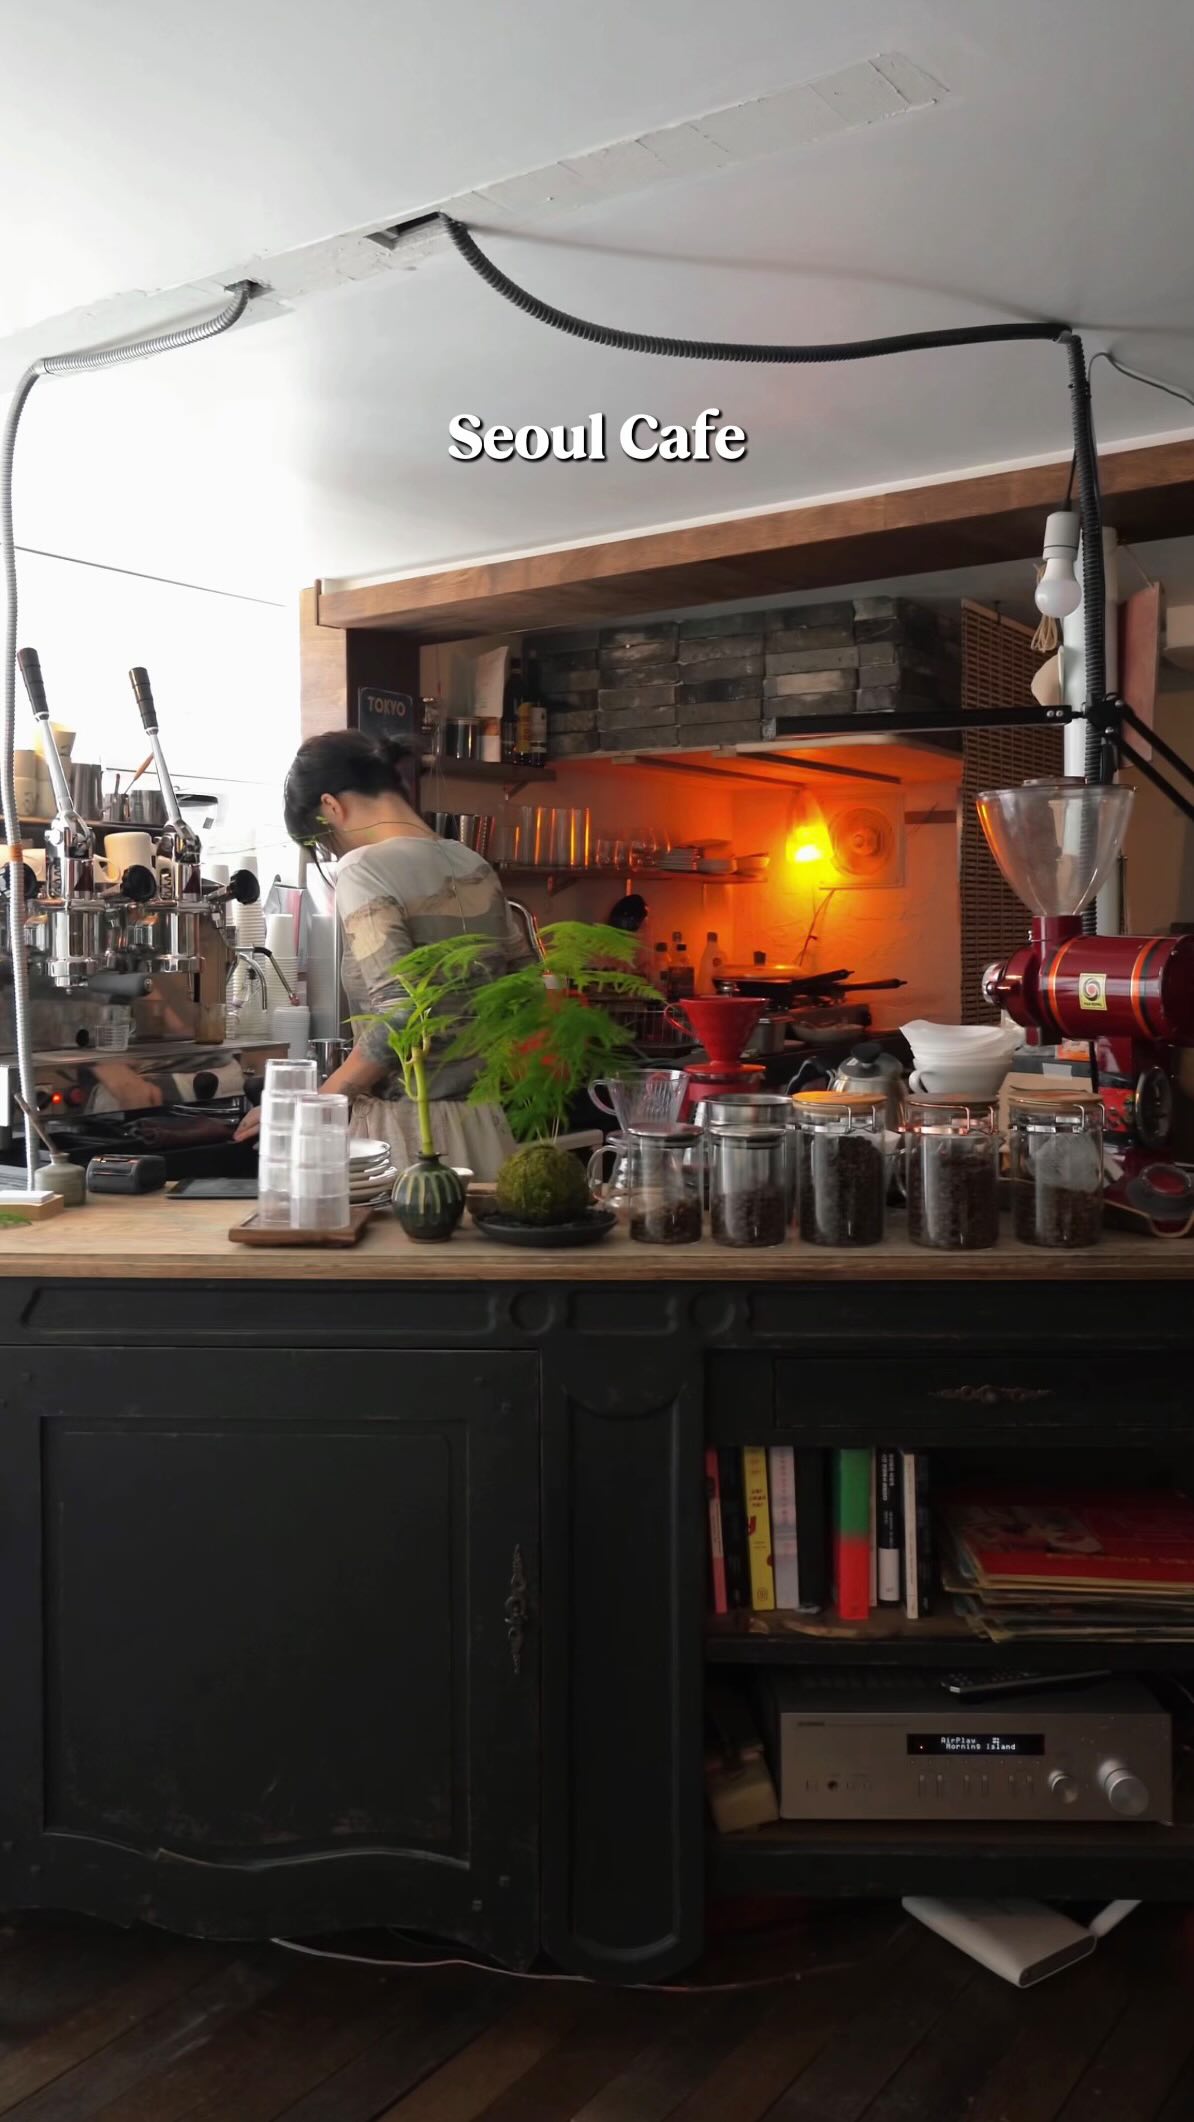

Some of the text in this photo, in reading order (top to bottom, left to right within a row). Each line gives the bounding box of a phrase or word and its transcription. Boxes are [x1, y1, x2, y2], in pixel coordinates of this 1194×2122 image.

[368, 696, 405, 716] TOKYO
[940, 1736, 977, 1744] AirPlay
[945, 1743, 982, 1751] Morning
